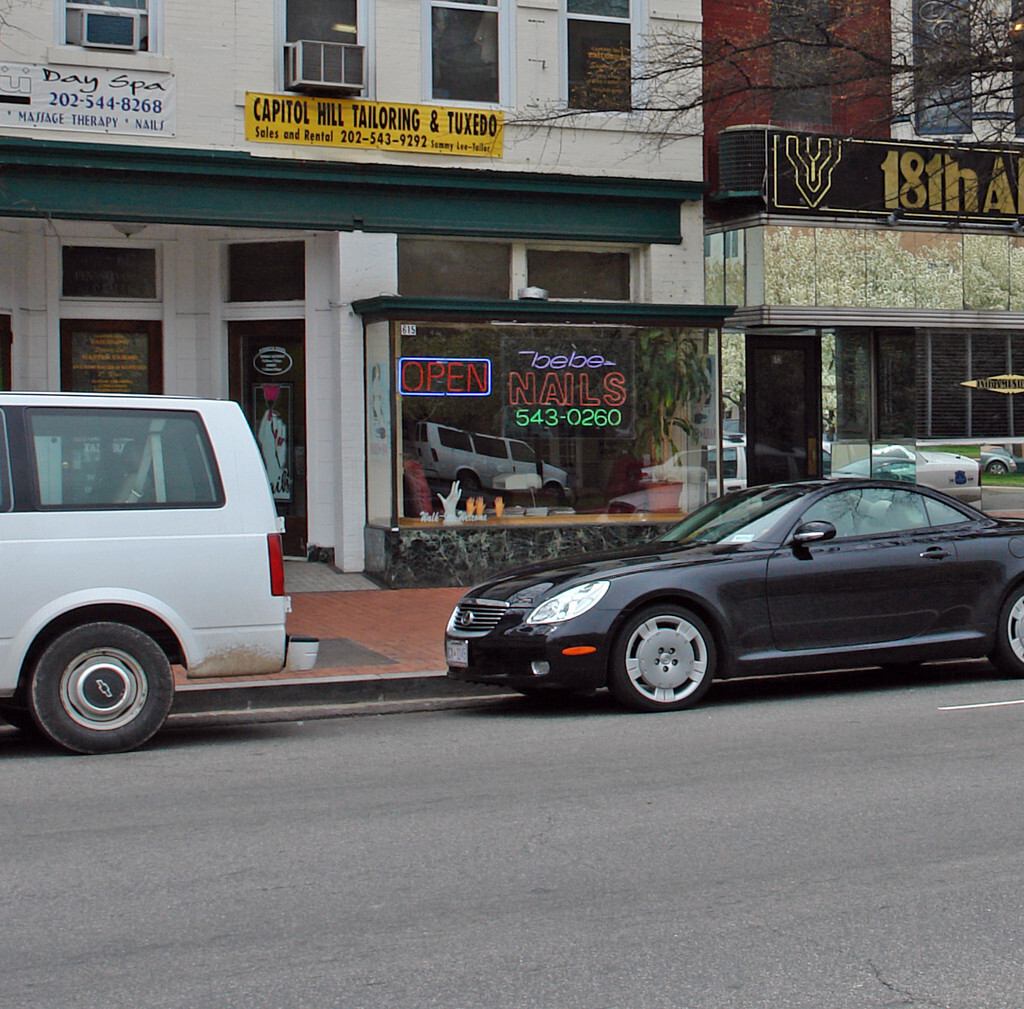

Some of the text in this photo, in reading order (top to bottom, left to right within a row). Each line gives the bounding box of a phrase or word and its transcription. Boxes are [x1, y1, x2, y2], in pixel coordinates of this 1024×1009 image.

[42, 68, 166, 96] Day Spa
[49, 91, 163, 114] 202-544-8268
[18, 111, 165, 131] MASSAGE THERAPY NAILS
[253, 97, 498, 137] CAPITOL HILL TAILORING & TUXEDO
[255, 126, 279, 138] Sales
[284, 128, 300, 140] and
[304, 129, 334, 142] Rental
[341, 130, 428, 148] 202-543-9292
[880, 150, 979, 213] 18th
[401, 325, 416, 335] 615
[518, 350, 617, 369] bebe
[401, 361, 488, 392] OPEN
[508, 371, 627, 407] NAILS
[516, 408, 622, 426] 543-0260
